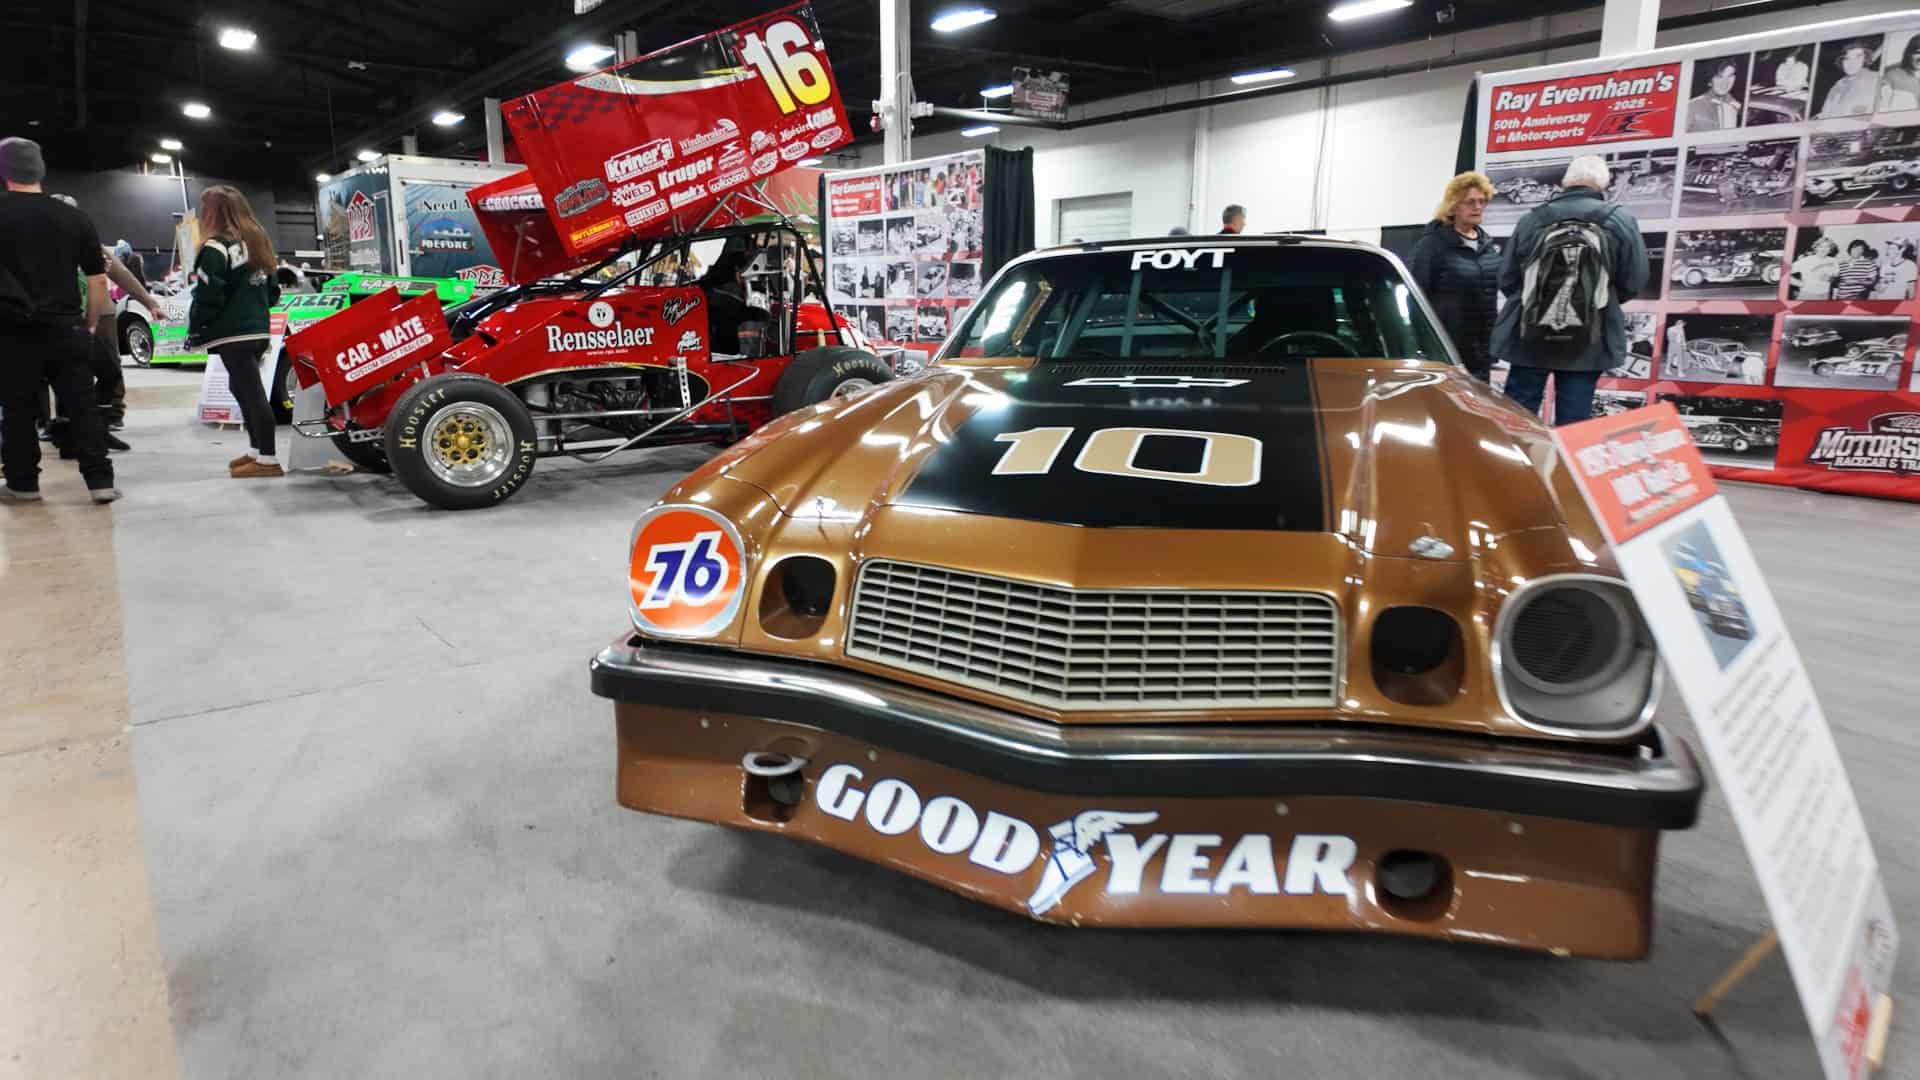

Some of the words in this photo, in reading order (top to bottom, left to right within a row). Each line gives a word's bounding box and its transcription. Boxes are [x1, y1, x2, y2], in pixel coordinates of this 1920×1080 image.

[741, 20, 830, 114] 16
[1496, 90, 1537, 113] Ray
[1539, 71, 1675, 107] Evernham's
[1494, 118, 1520, 130] 50th
[1495, 133, 1506, 143] in
[1507, 126, 1585, 143] Motorsports
[606, 142, 673, 179] Kriner's
[658, 156, 714, 190] Kruger
[423, 199, 457, 211] Need
[622, 183, 652, 201] WELD
[1130, 248, 1235, 271] FOYT
[546, 321, 655, 352] Rensselaer
[991, 427, 1263, 487] 10
[1833, 456, 1888, 468] RACECAR
[642, 533, 727, 607] 76
[815, 763, 1040, 875] GOOD
[1105, 833, 1359, 897] YEAR
